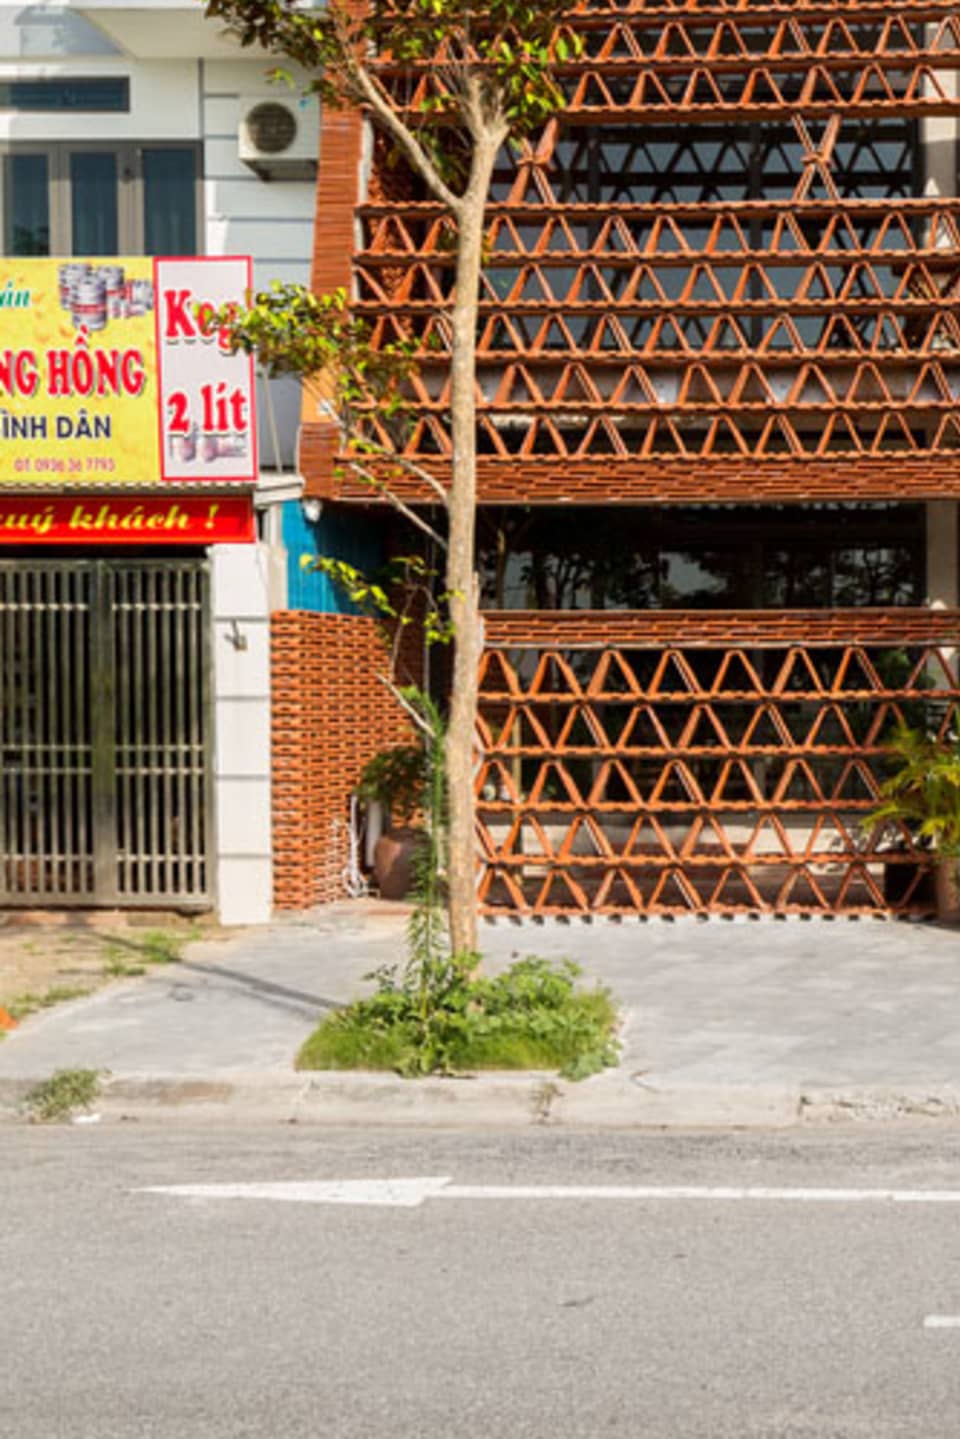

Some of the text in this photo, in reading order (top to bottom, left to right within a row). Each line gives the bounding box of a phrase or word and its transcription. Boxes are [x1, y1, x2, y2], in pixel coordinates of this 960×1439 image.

[47, 324, 145, 395] HỒNG
[56, 408, 111, 438] DÂN
[167, 382, 247, 433] 2 lít
[0, 504, 219, 534] uý khách !
